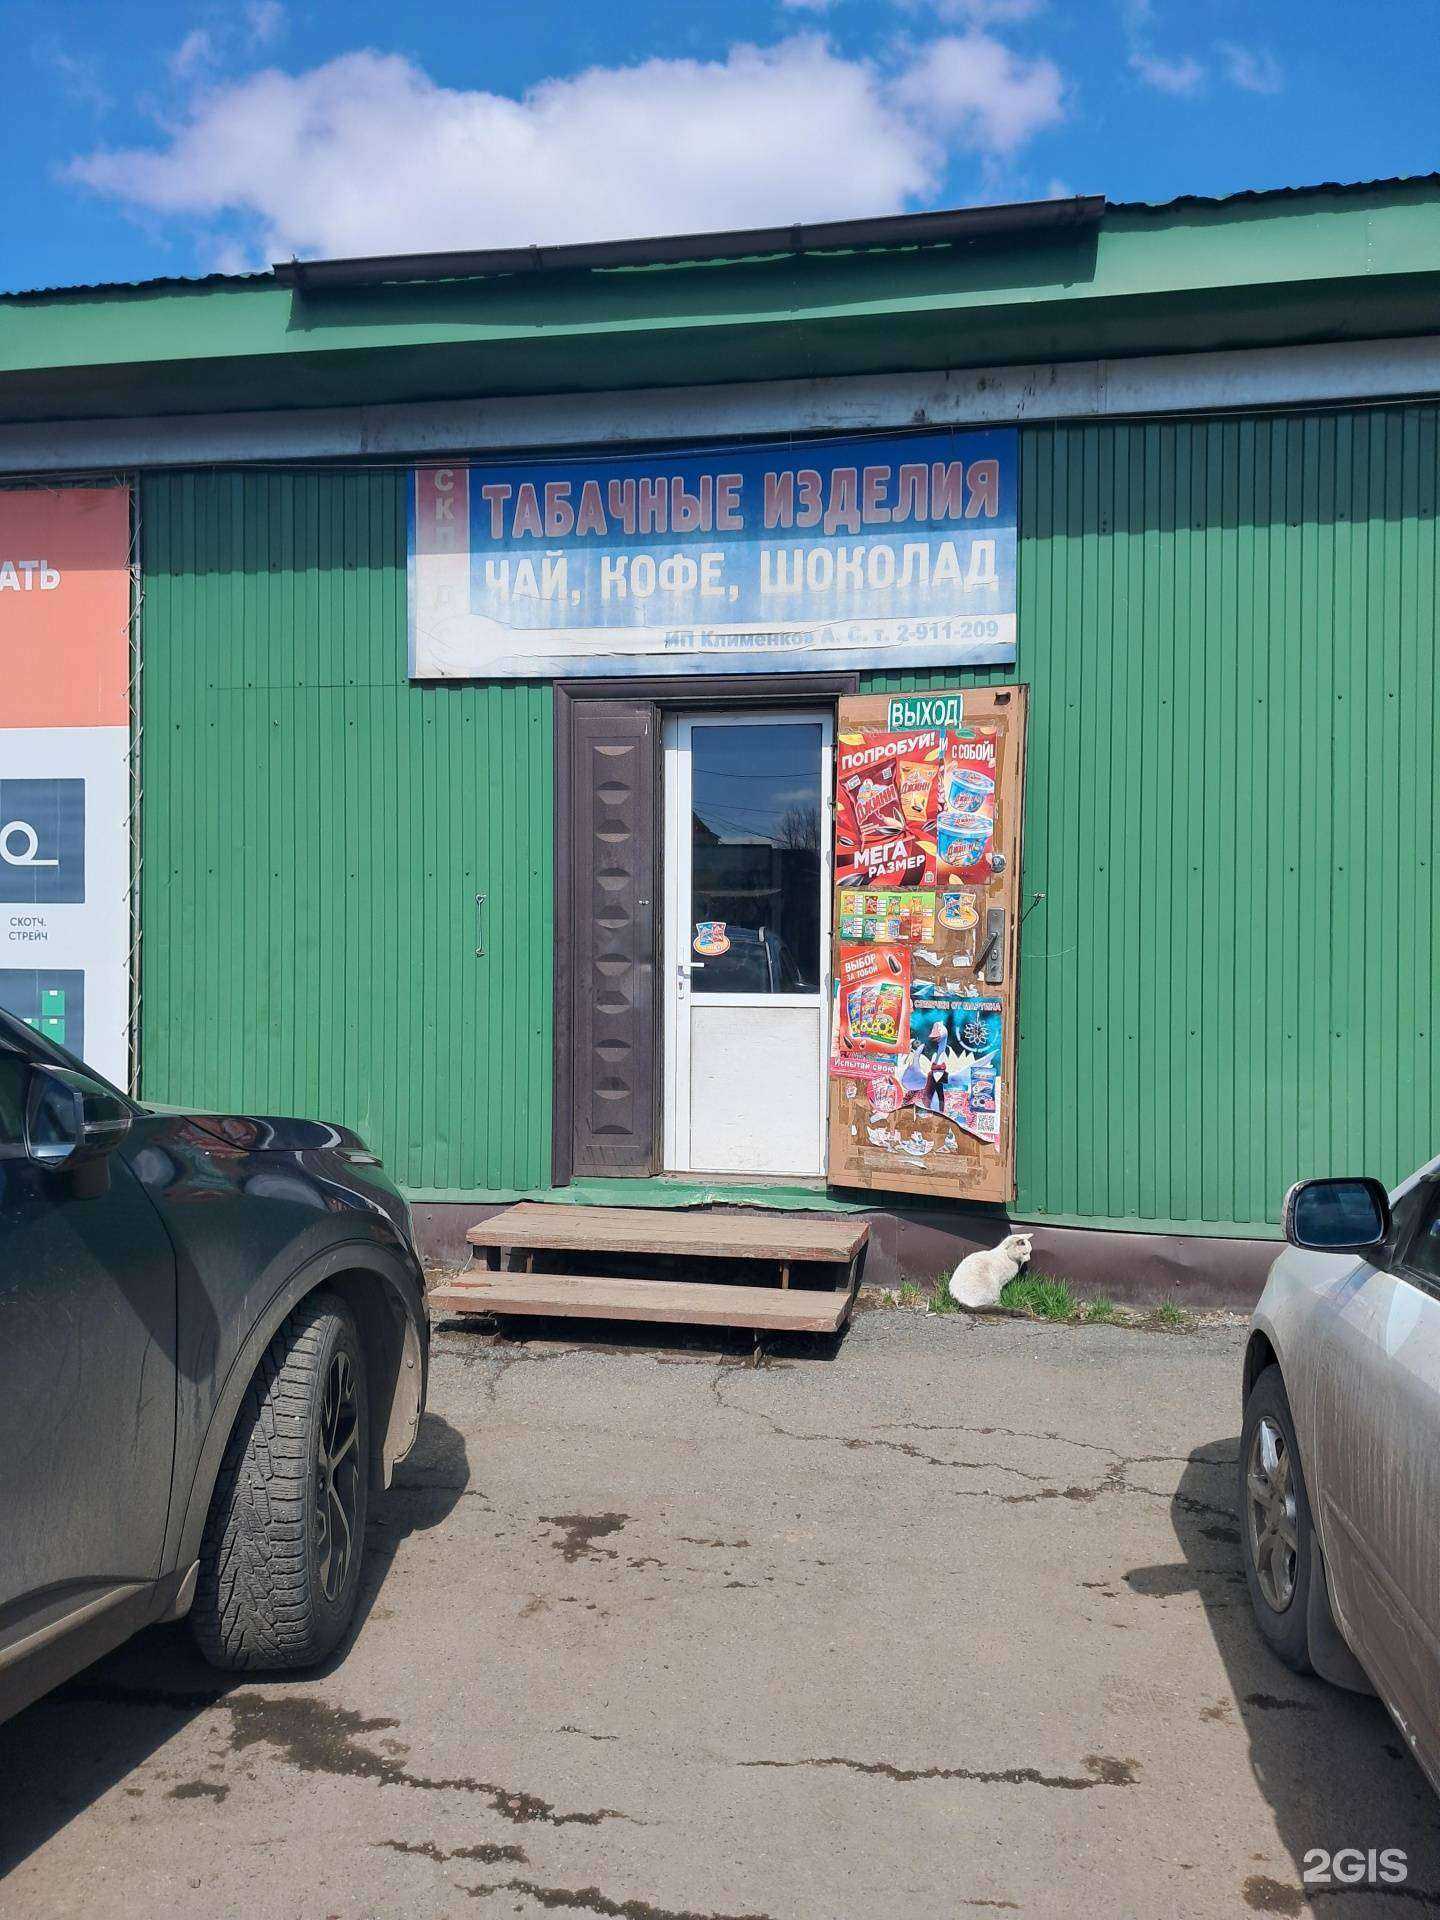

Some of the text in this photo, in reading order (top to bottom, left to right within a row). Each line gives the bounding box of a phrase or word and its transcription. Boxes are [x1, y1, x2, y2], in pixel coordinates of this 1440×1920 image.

[482, 459, 1000, 539] ТАБАЧНЫЕ ИЗДЕЛИЯ
[485, 539, 999, 607] ЧАЙ, КОФЕ, ШОКОЛАД
[700, 630, 814, 648] Клименков
[897, 620, 999, 641] 2-911-209
[892, 699, 958, 727] ВЫХОД
[841, 731, 936, 770] ПОПРОБУЙ!
[958, 740, 994, 761] СОБОЙ!
[853, 839, 908, 869] МЕГА
[868, 854, 926, 878] РАЗМЕР
[10, 917, 47, 926] СКОТЧ.
[9, 929, 48, 941] СТРЕЙЧ
[845, 953, 877, 973] ВЫБОР
[834, 1058, 871, 1070] Испытай
